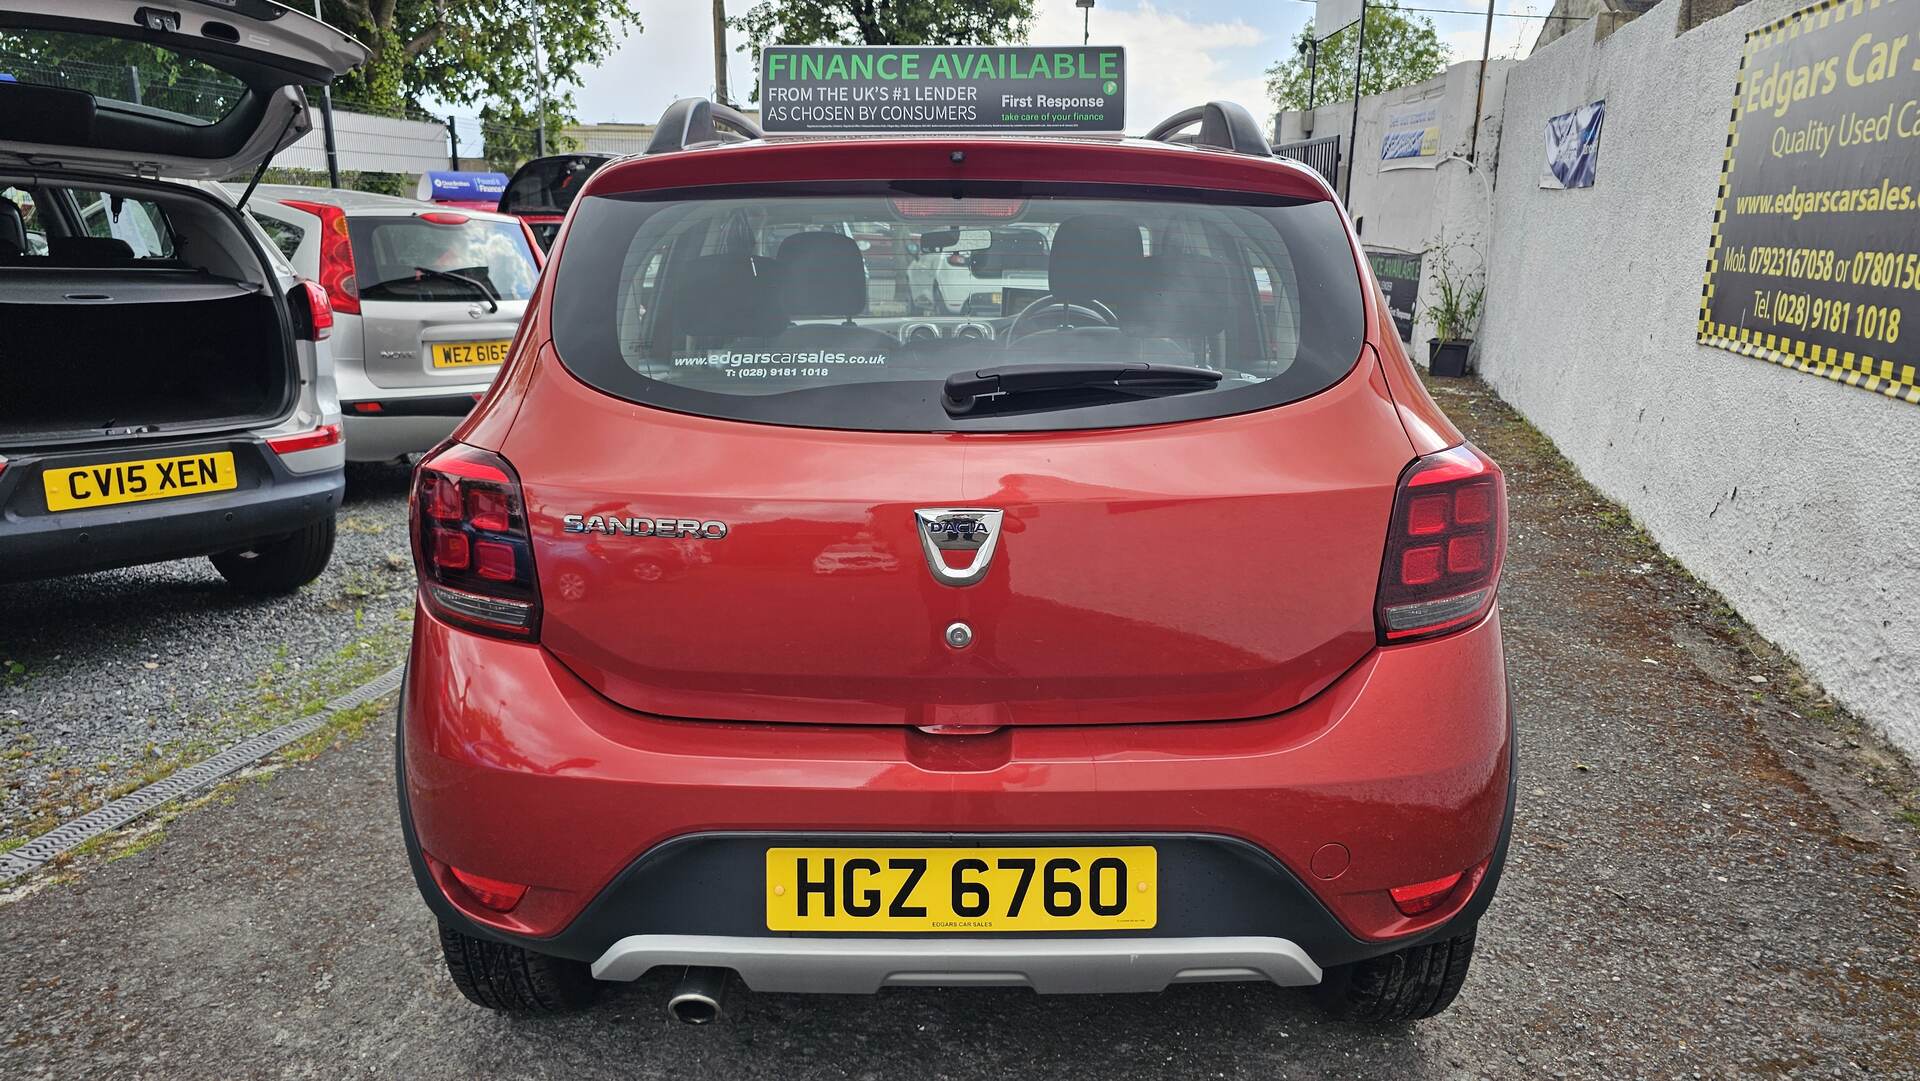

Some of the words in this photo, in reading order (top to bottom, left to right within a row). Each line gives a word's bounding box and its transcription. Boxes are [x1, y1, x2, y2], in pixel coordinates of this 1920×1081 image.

[768, 54, 920, 80] FINANCE
[929, 53, 1118, 79] AVAILABLE
[1746, 56, 1839, 118] Edgars
[1846, 33, 1908, 87] Car
[768, 87, 812, 101] FROM
[817, 87, 848, 101] THE
[853, 86, 889, 101] UK’S
[893, 86, 910, 101] #1
[915, 86, 977, 101] LENDER
[1001, 94, 1032, 107] First
[1037, 94, 1104, 110] Response
[768, 106, 787, 121] AS
[791, 106, 854, 121] CHOSEN
[859, 106, 879, 121] BY
[881, 105, 977, 121] CONSUMERS
[1001, 113, 1019, 121] take
[1041, 113, 1050, 121] of
[1052, 114, 1071, 122] your
[1073, 113, 1104, 121] finance
[1772, 119, 1835, 158] Quality
[1839, 103, 1894, 146] Used
[1736, 178, 1920, 220] www.edgarscarsales.
[1723, 246, 1746, 272] Mob.
[1749, 246, 1834, 281] 07923167058
[1835, 259, 1851, 283] or
[1754, 290, 1770, 319] Tel.
[1773, 290, 1810, 332] (028)
[1811, 298, 1851, 334] 9181
[1855, 304, 1901, 343] 1018
[443, 346, 472, 364] WEZ
[476, 344, 508, 361] 6165
[674, 350, 885, 367] www.edgarscarsales.co.uk
[725, 369, 736, 377] T:
[738, 368, 767, 377] (028)
[770, 368, 797, 376] 9181
[800, 368, 828, 376] 1018
[68, 465, 147, 500] CV15
[156, 457, 218, 490] XEN
[563, 514, 727, 539] SANDERO
[930, 521, 988, 533] DACIA
[797, 858, 927, 917] HGZ
[951, 857, 1128, 917] 6760
